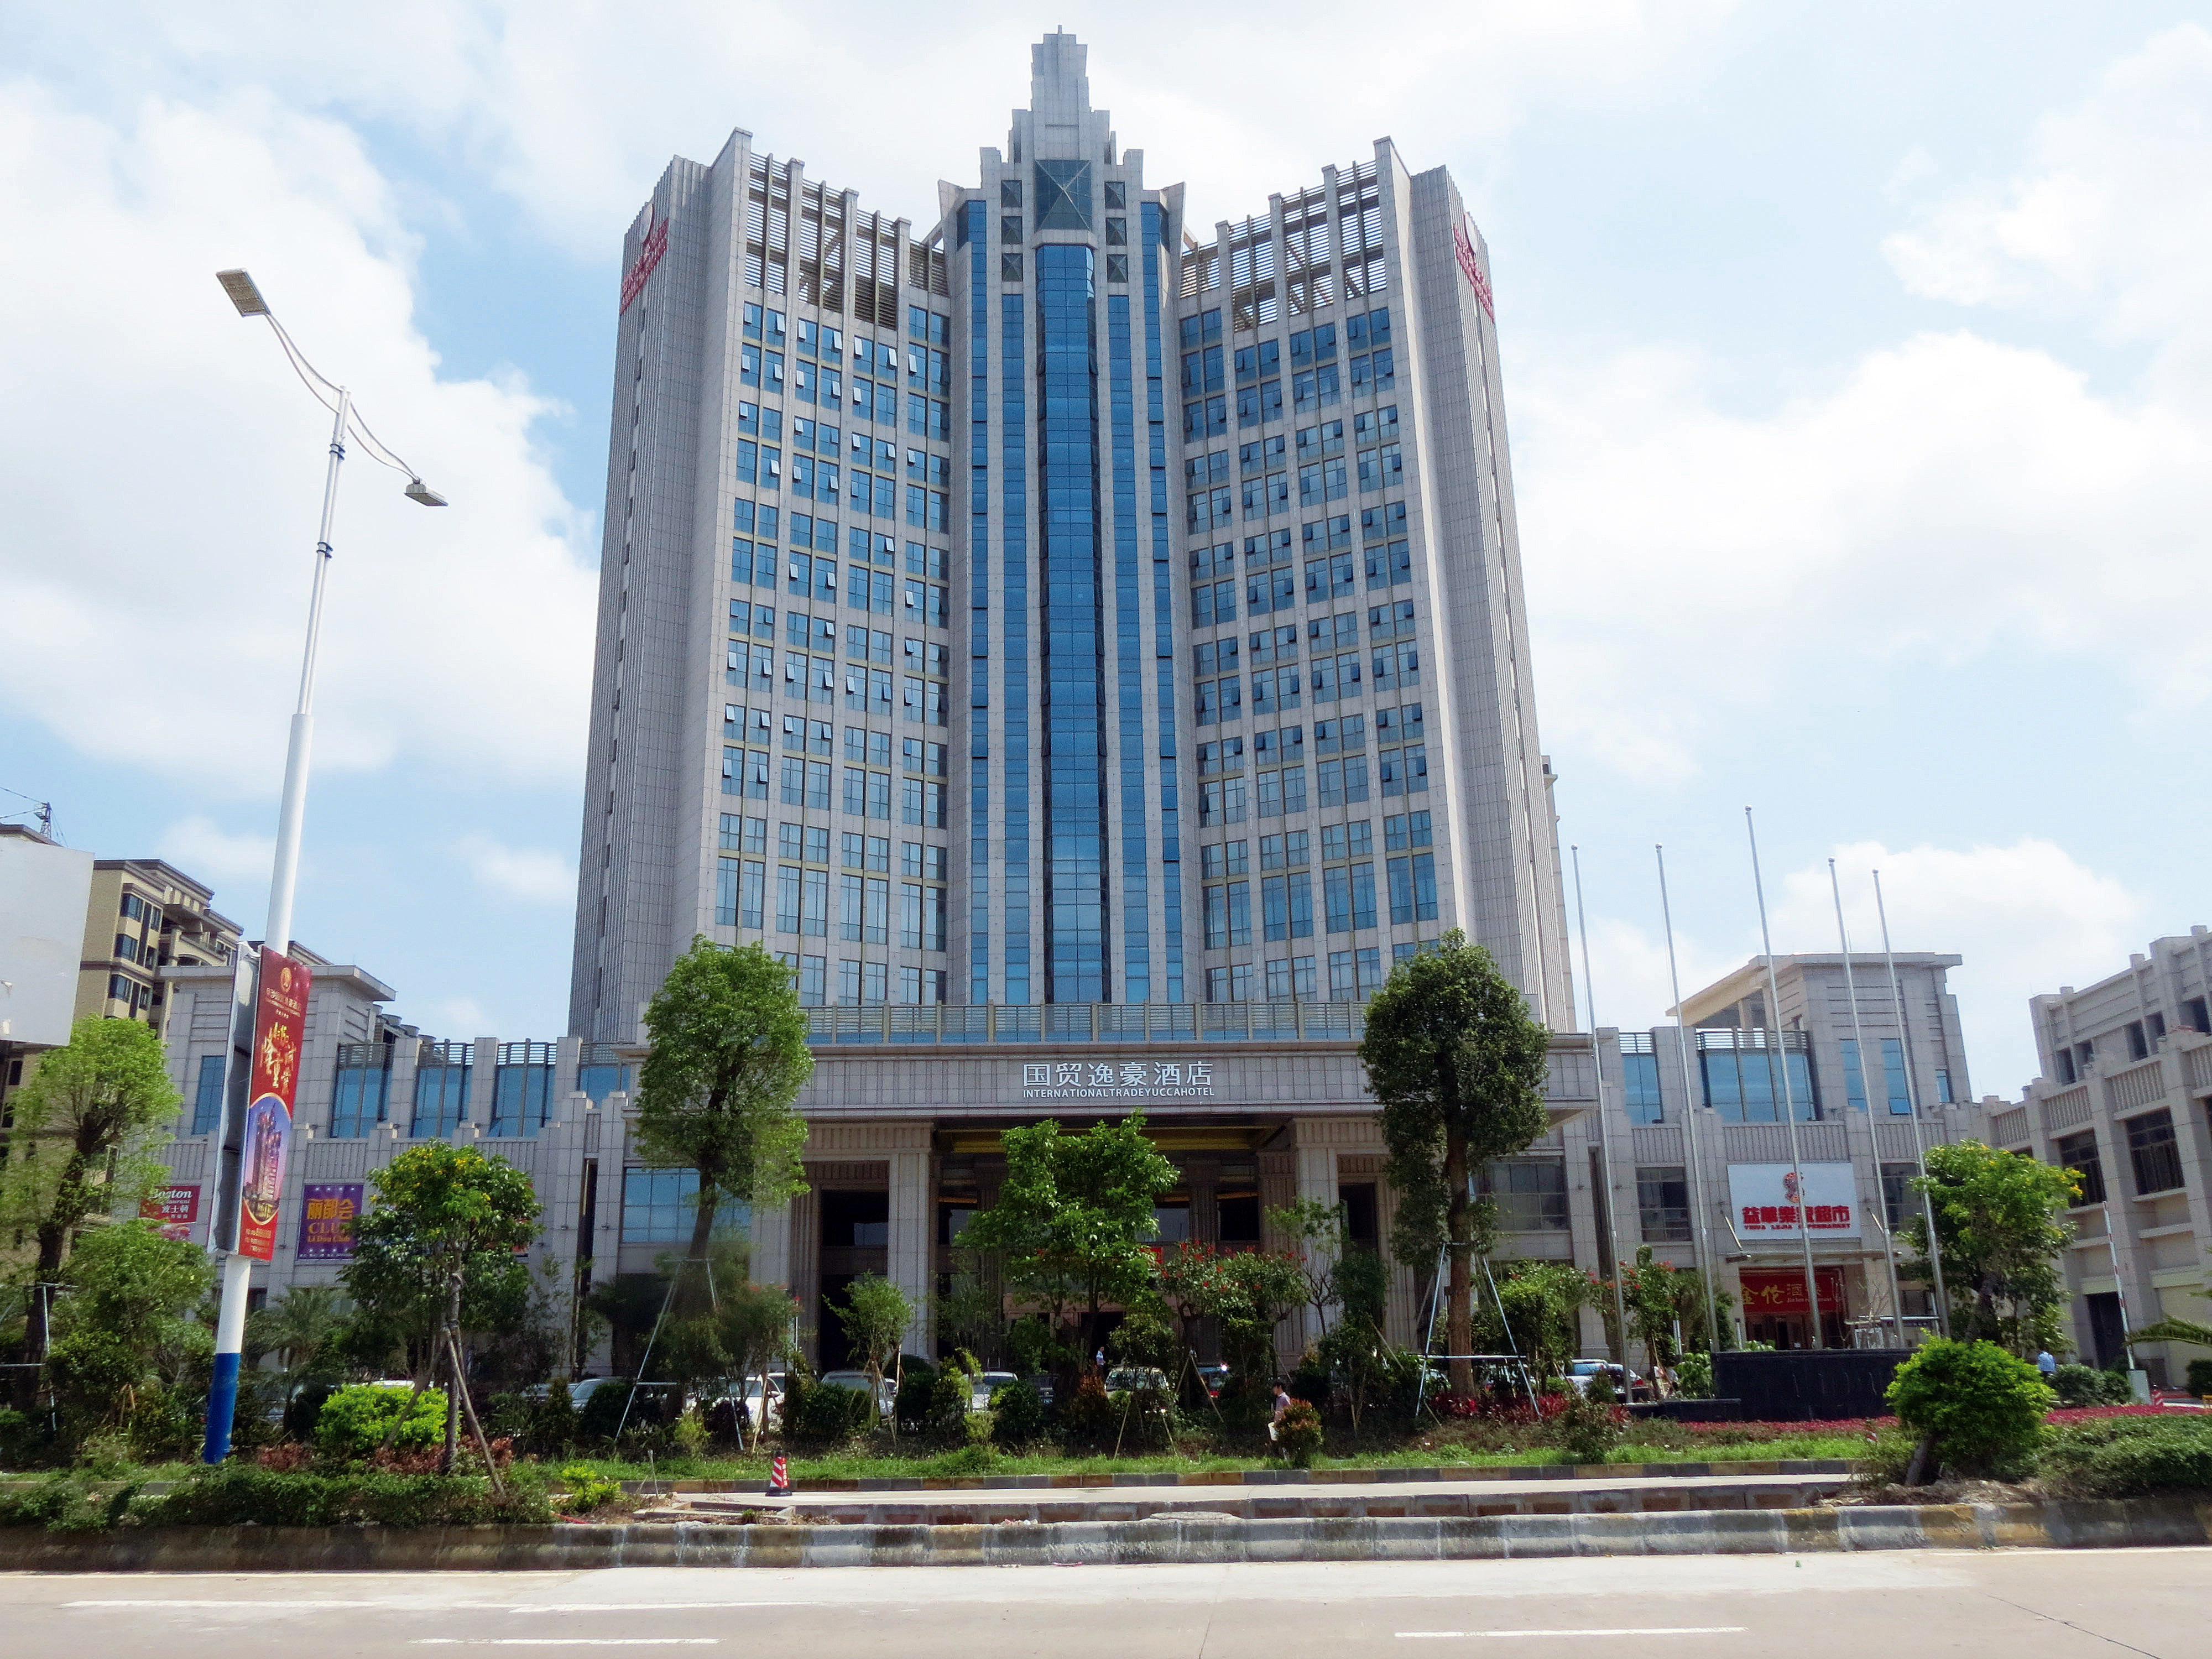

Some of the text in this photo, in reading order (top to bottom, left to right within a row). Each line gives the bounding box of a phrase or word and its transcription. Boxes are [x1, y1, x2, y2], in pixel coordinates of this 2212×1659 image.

[1023, 1061, 1213, 1087] 国贸逸豪酒店
